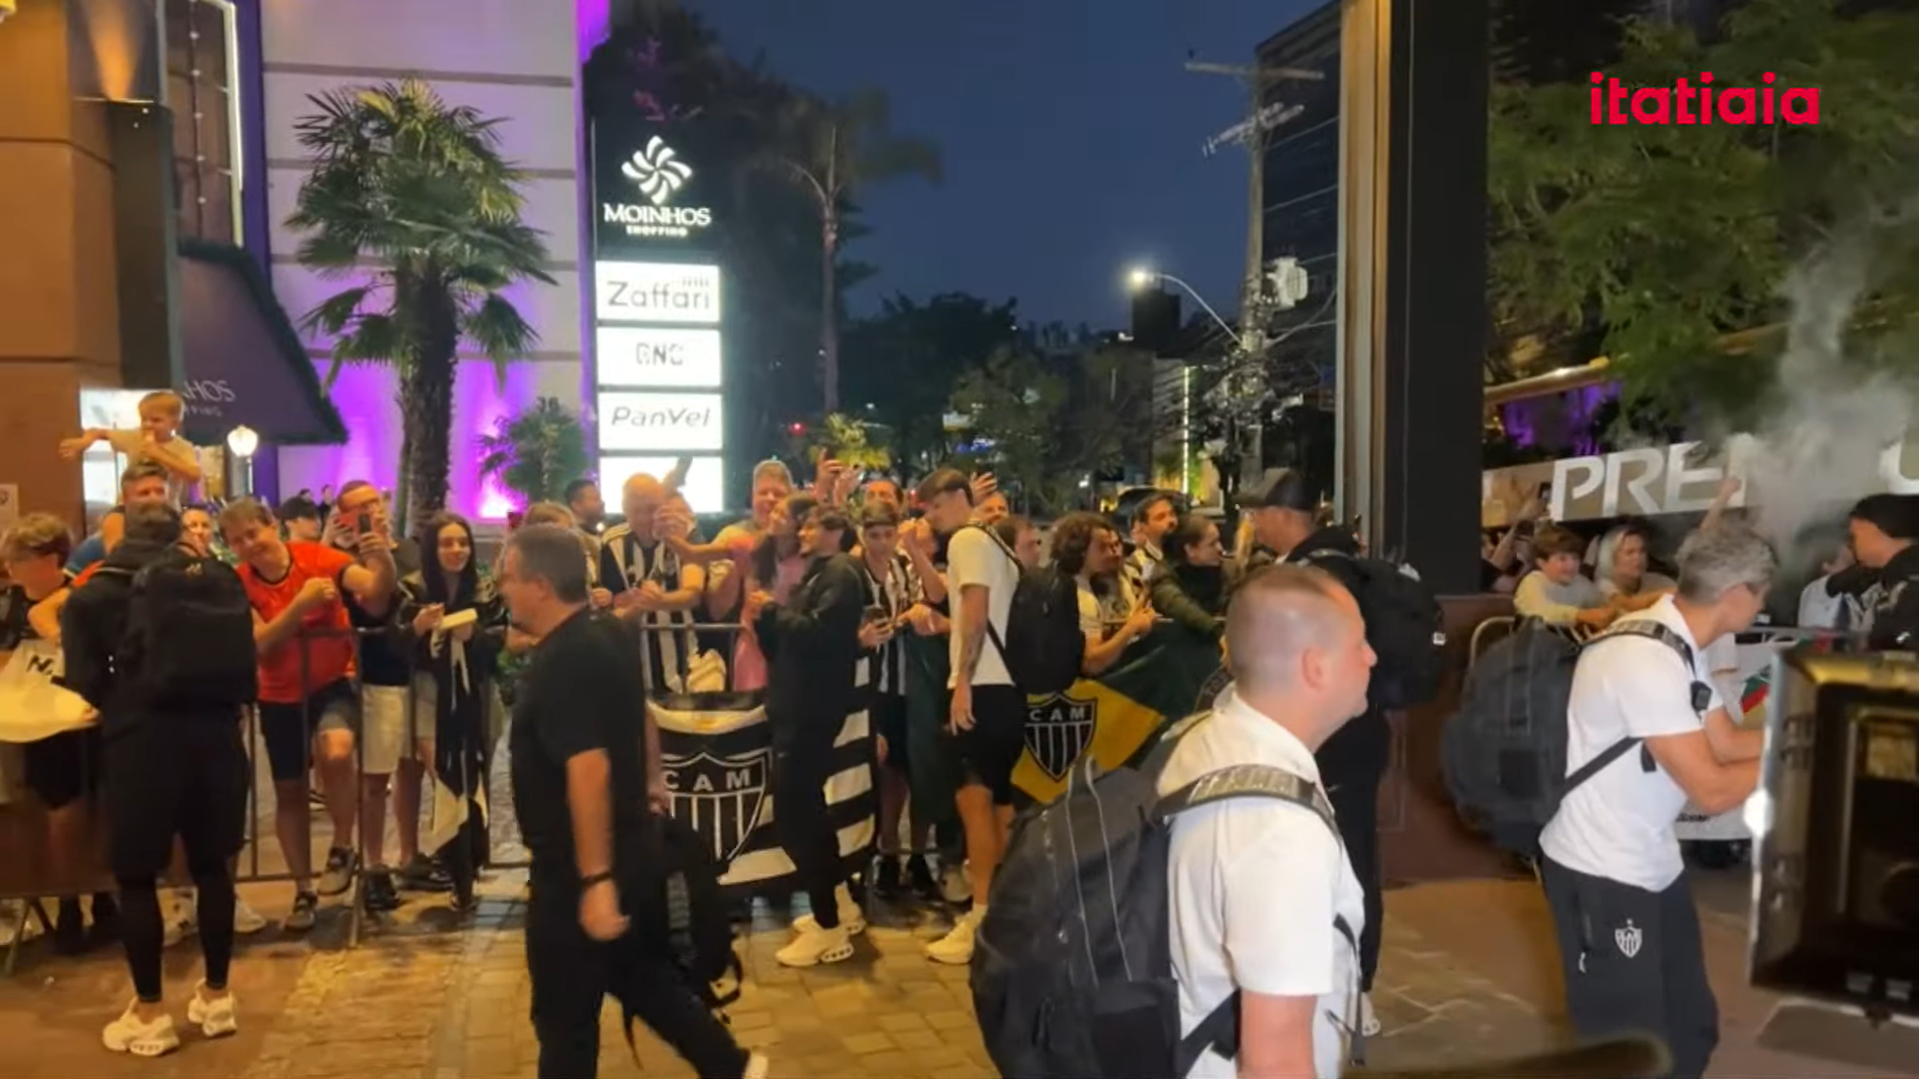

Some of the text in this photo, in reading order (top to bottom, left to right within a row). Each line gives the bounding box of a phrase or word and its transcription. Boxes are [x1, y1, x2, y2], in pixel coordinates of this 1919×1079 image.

[603, 203, 712, 227] MOINHOS
[607, 279, 710, 310] Zaffari
[663, 767, 751, 793] CAM
